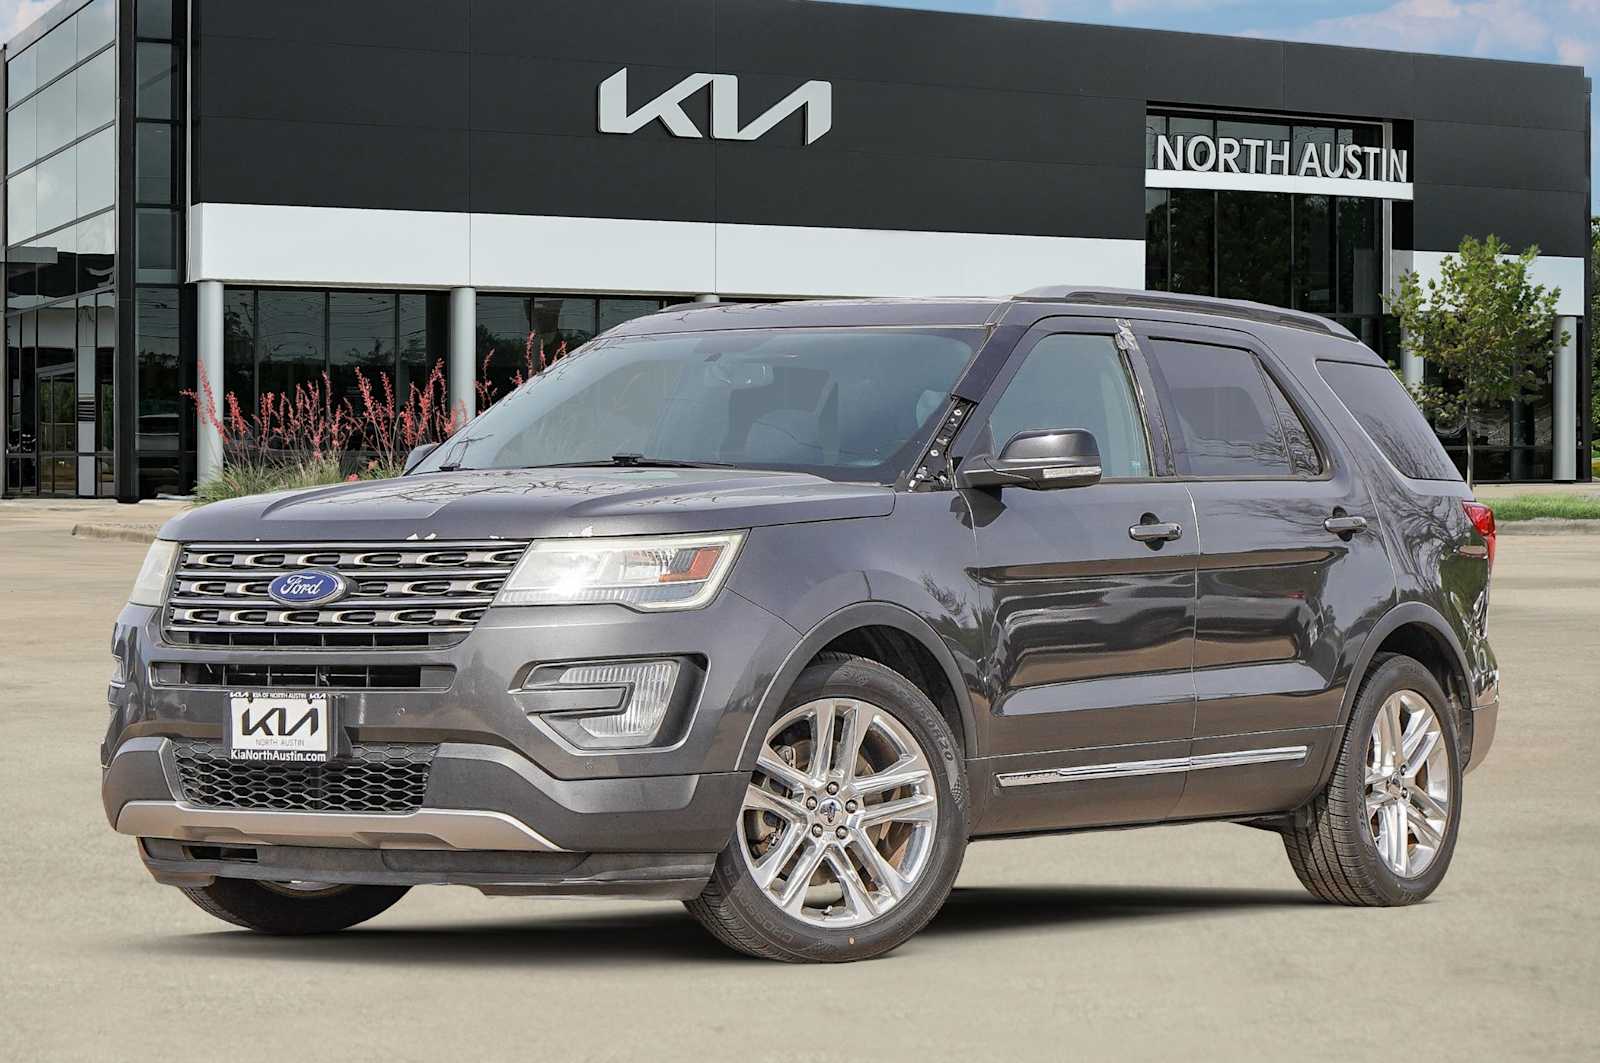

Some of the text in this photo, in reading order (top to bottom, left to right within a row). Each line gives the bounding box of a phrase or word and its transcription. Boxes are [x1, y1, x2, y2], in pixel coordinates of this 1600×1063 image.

[599, 67, 832, 145] KIA
[1156, 134, 1408, 183] NORTH AUSTIN
[280, 574, 324, 595] Ford
[288, 692, 307, 700] AUSTIN
[242, 707, 319, 736] KIA
[255, 738, 305, 748] NORTH AUSTIN
[230, 749, 327, 762] KiaNorthAustin.com
